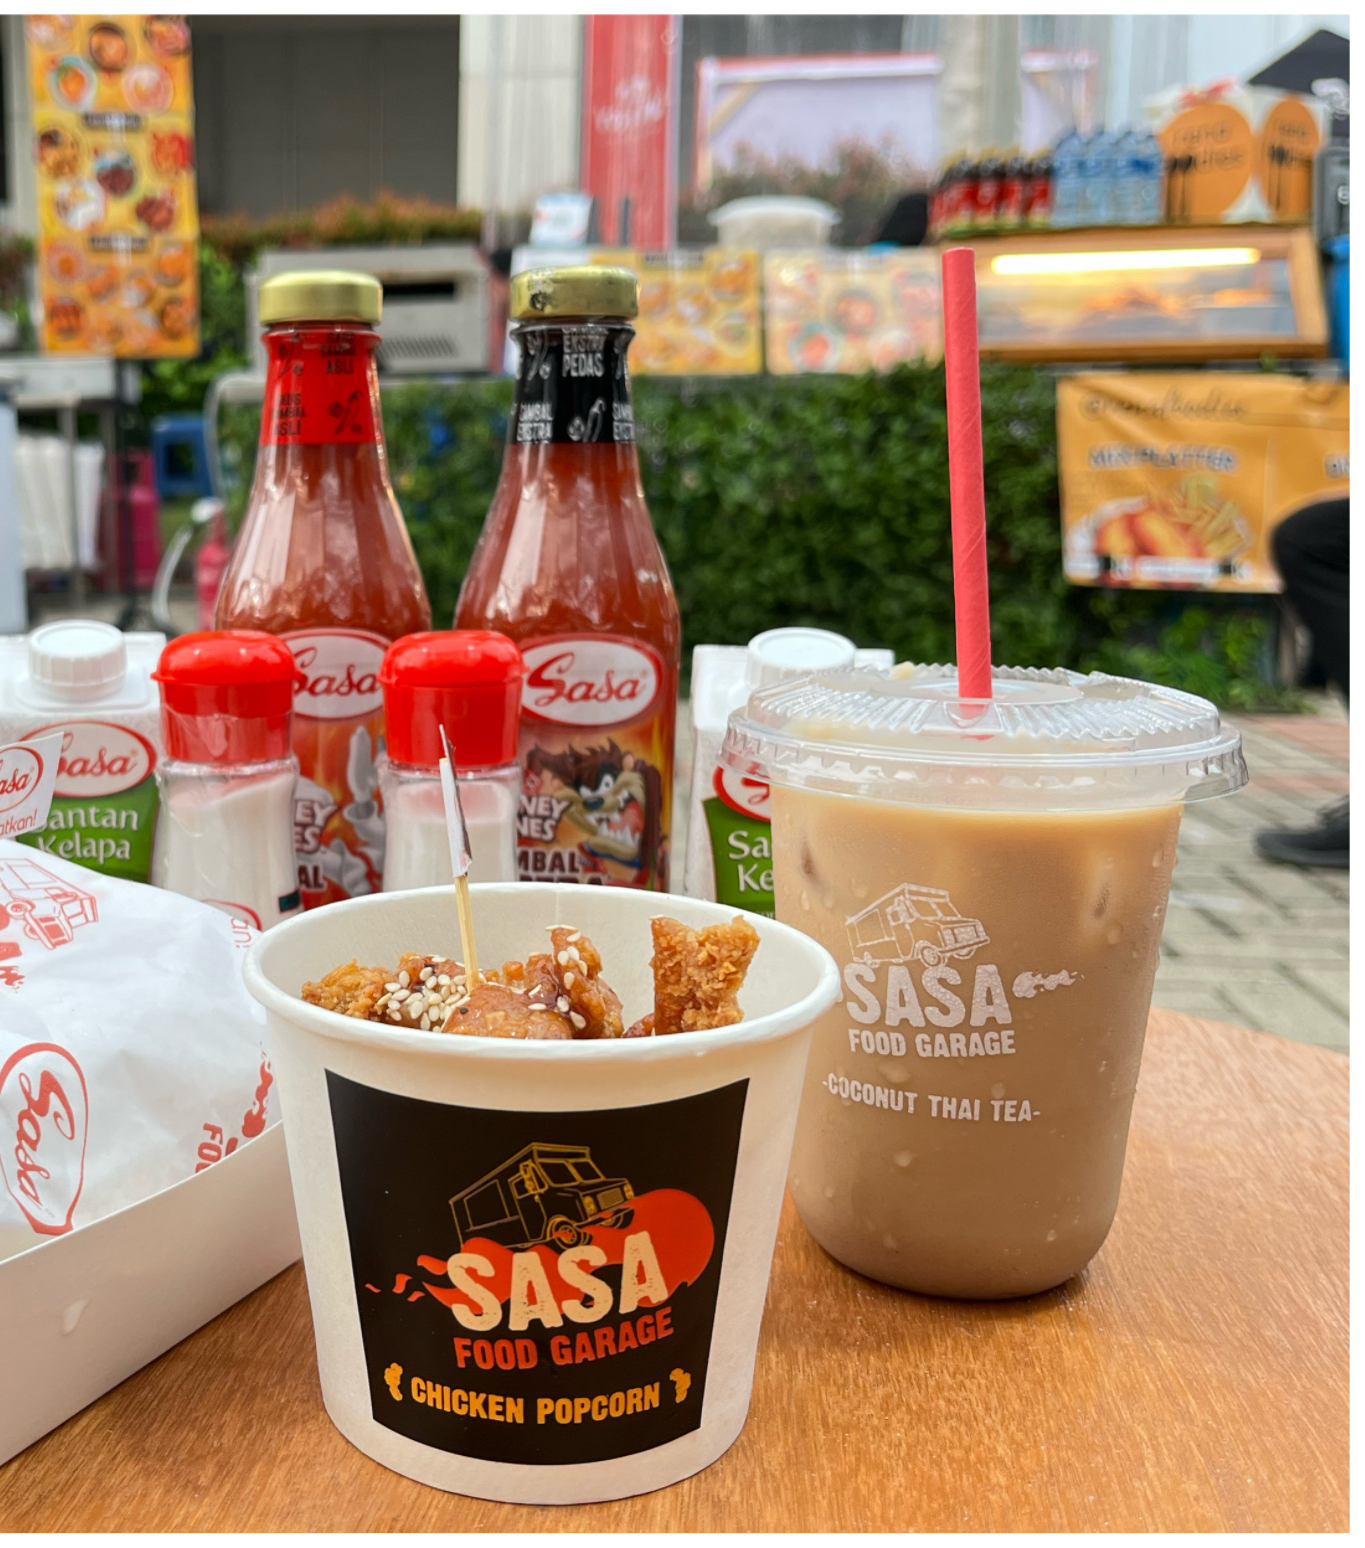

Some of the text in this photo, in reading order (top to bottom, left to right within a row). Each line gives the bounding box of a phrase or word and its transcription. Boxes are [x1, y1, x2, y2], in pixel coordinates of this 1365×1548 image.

[326, 359, 354, 375] ASLI
[562, 353, 605, 378] PEDAS
[526, 652, 642, 707] Sasa
[39, 806, 140, 832] antan
[519, 796, 570, 819] NEY
[518, 819, 557, 843] NES
[37, 832, 132, 865] Kelapa
[518, 850, 582, 874] MBAL
[843, 963, 1014, 1028] SASA
[847, 1029, 1016, 1058] FOOD GARAGE
[822, 1072, 1041, 1123] -COCONUT THAI TEA-
[15, 1069, 76, 1211] Sasa
[446, 1230, 669, 1331] SASA
[453, 1306, 674, 1370] FOOD GARAGE
[411, 1376, 660, 1424] CHICKEN POPCORN
